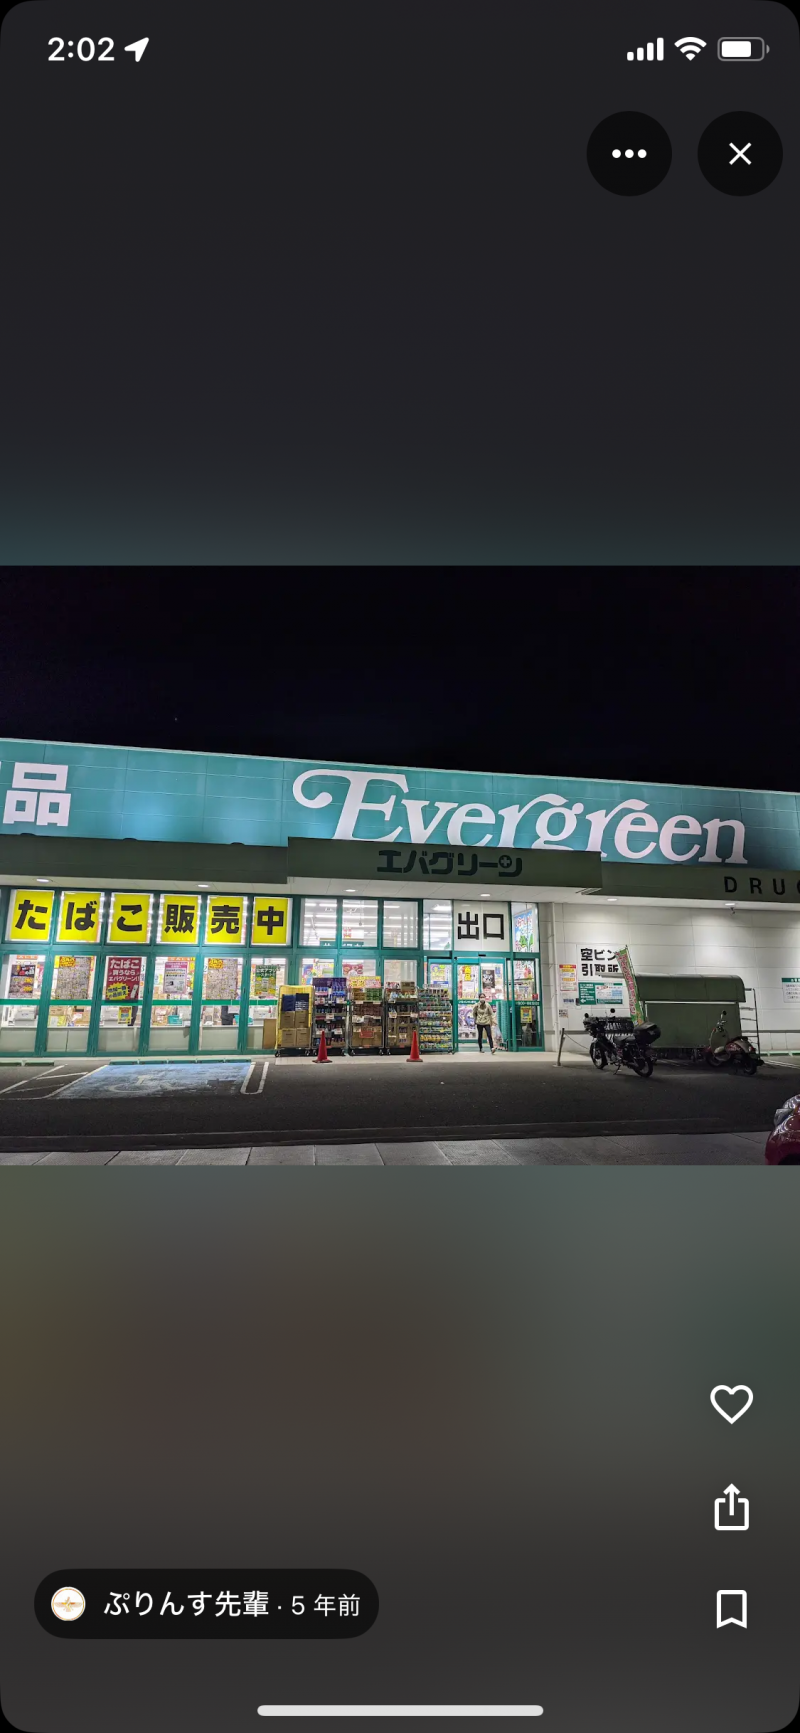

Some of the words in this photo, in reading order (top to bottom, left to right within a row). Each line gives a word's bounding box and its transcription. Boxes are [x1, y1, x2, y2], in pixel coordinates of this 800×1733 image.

[0, 762, 71, 827] 品
[292, 769, 748, 865] Evergreen
[377, 850, 523, 877] エバグリーン
[724, 876, 800, 896] DRU
[15, 899, 284, 936] たばこ販売中
[458, 911, 504, 940] 出口
[110, 959, 139, 969] たばこ
